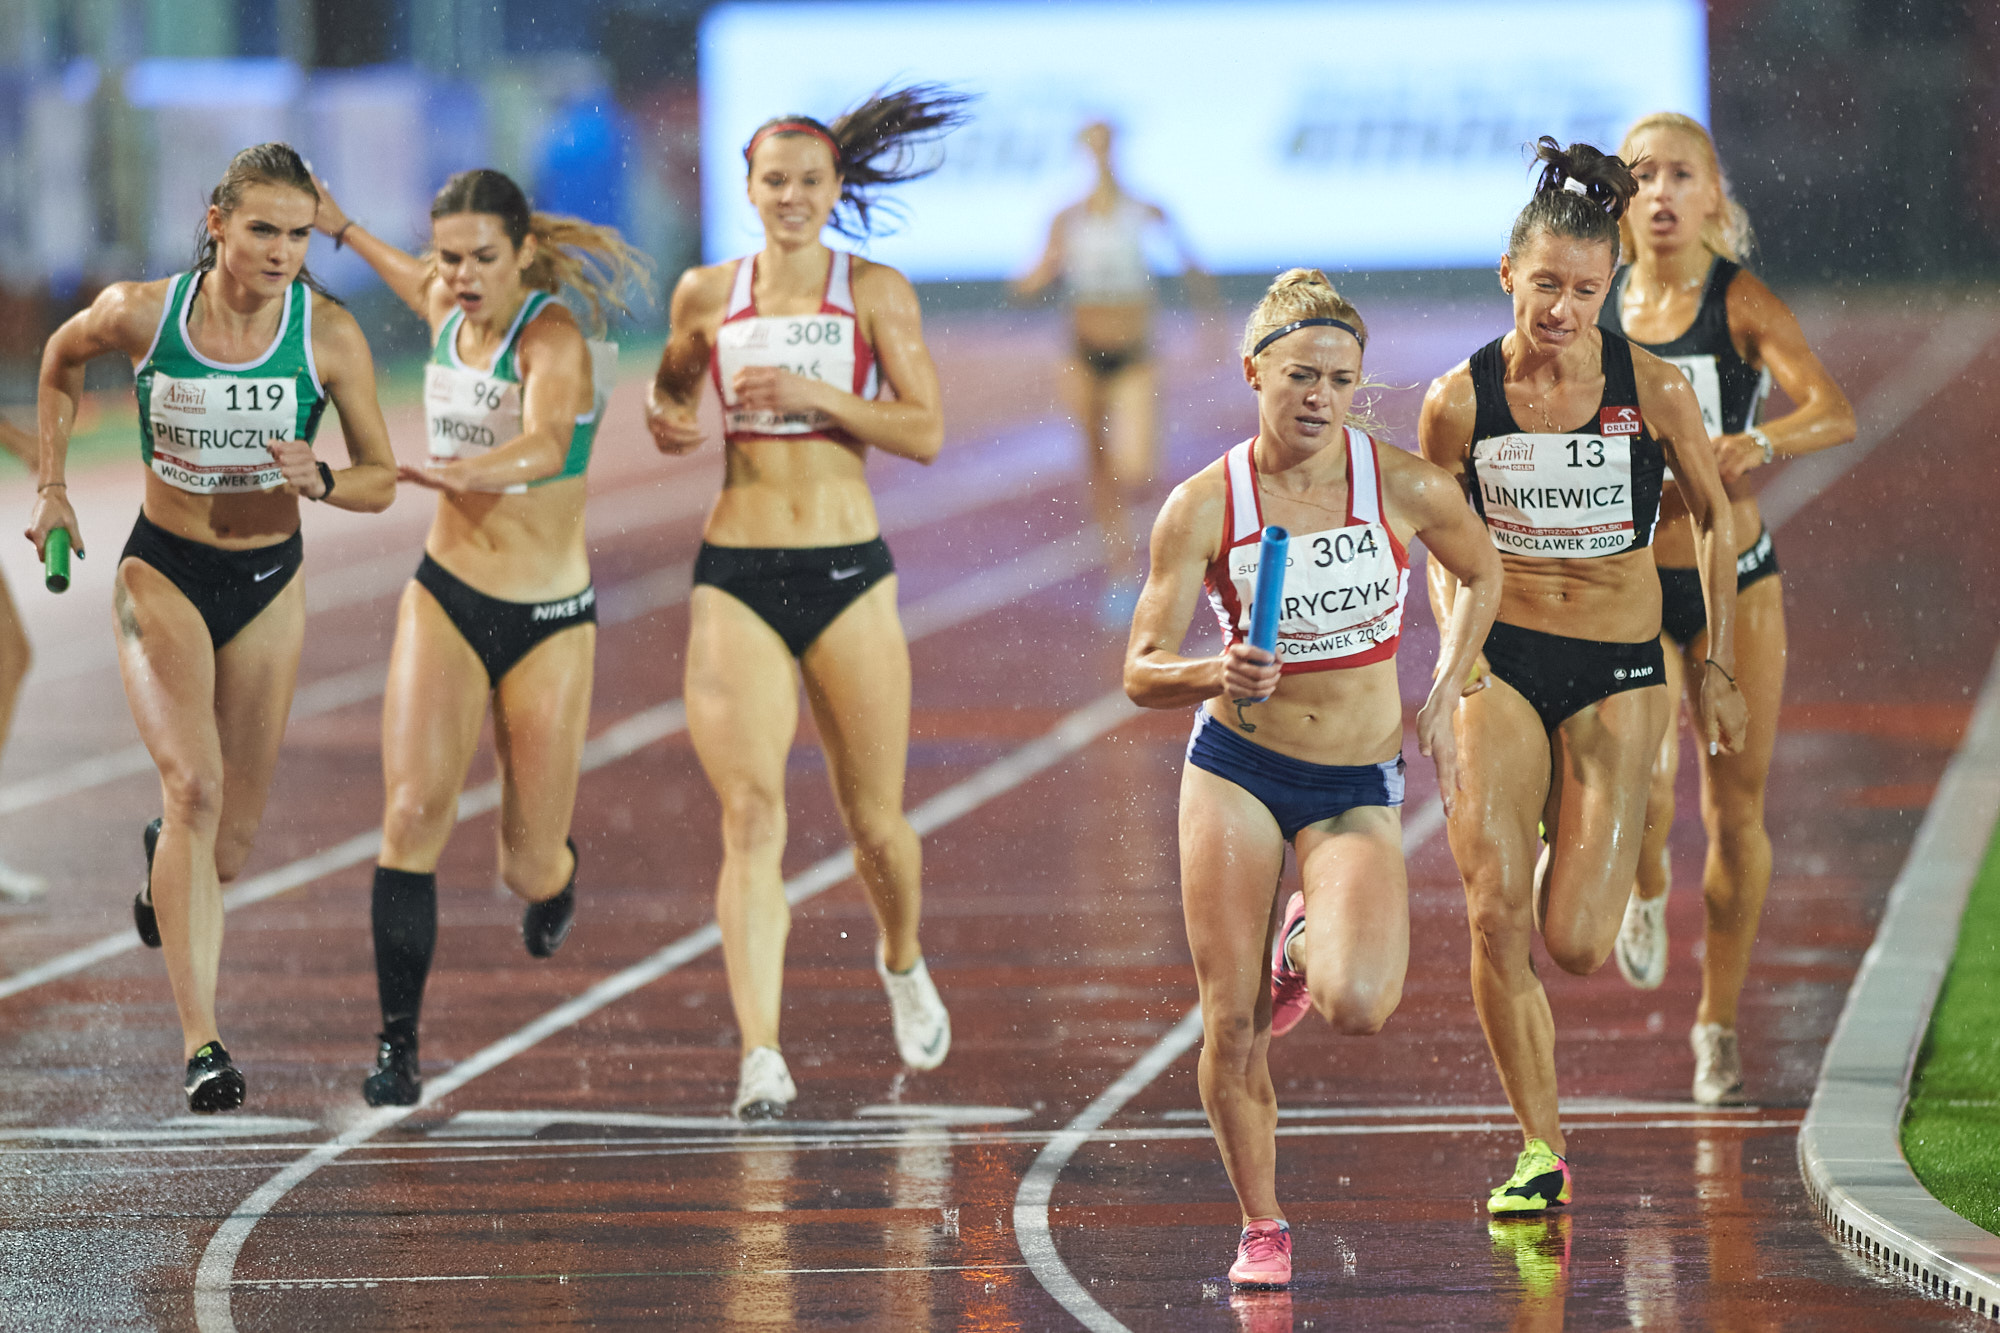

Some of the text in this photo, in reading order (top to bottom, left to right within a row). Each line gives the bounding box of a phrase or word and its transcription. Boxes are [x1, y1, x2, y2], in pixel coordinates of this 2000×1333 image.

[786, 321, 841, 345] 308
[164, 384, 206, 405] Anwil
[226, 384, 284, 411] 119
[474, 381, 501, 410] 96
[157, 422, 289, 449] PIETRUCZUK
[1606, 423, 1636, 432] ORLEN
[1565, 439, 1605, 468] 13
[161, 463, 248, 487] WŁOCŁAWEK
[1484, 484, 1624, 509] LINKIEWICZ
[1495, 530, 1625, 551] WŁOCŁAWEK 2020
[1591, 523, 1623, 534] POLSKI
[1312, 529, 1379, 568] 304
[532, 599, 578, 621] NIKE
[1249, 578, 1390, 622] RYCZYK
[1275, 632, 1354, 656] OCŁAWEK
[1357, 621, 1388, 643] 2020
[1630, 665, 1654, 679] JAKO
